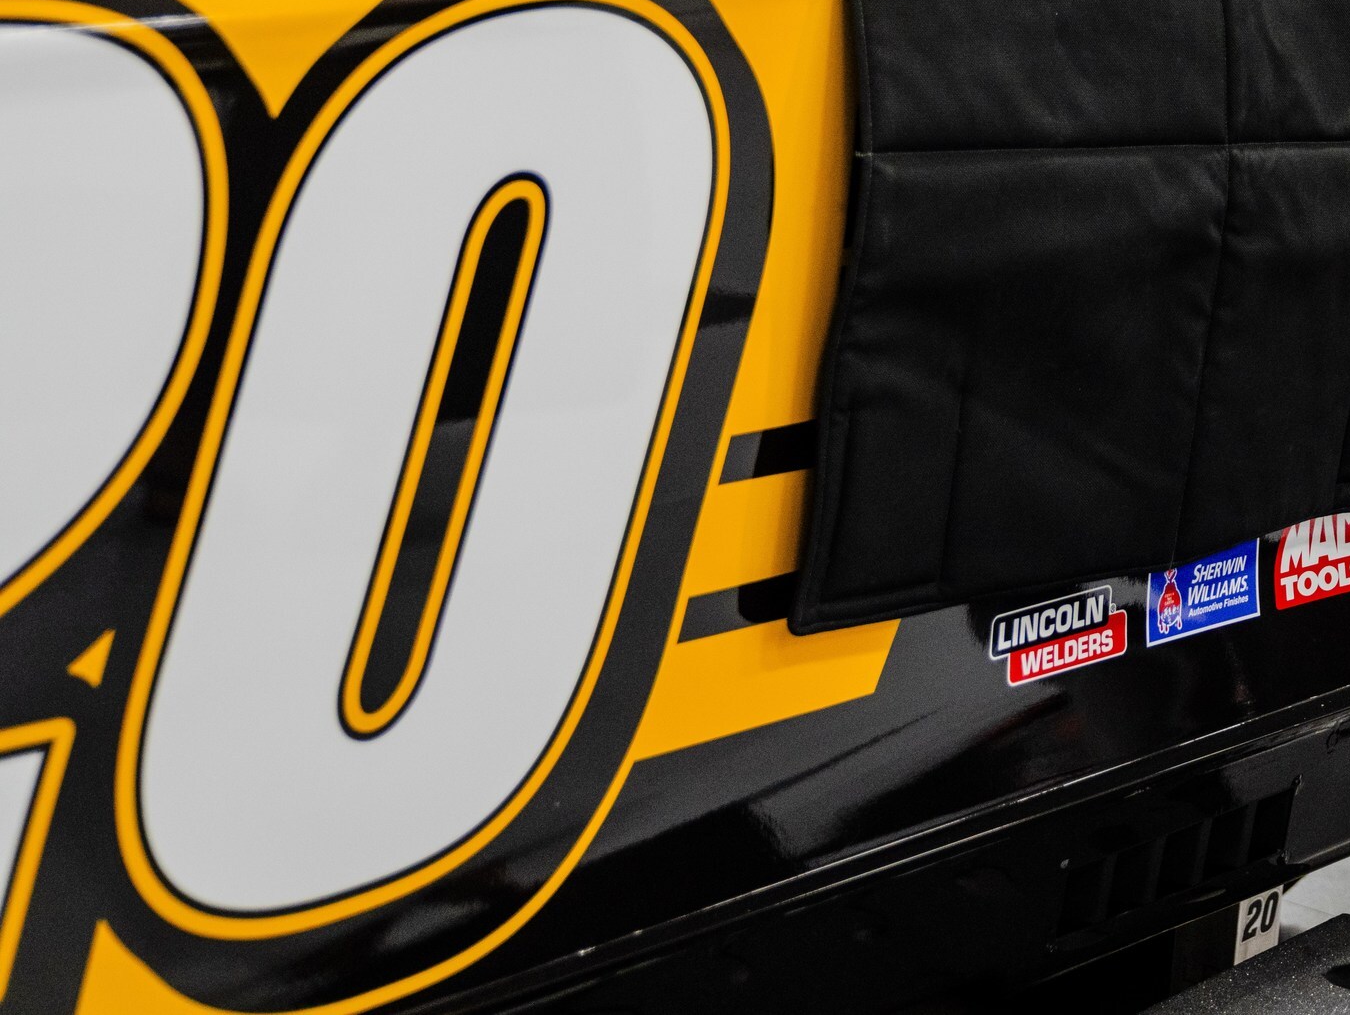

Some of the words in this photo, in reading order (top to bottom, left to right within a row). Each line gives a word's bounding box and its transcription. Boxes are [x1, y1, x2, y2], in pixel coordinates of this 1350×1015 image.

[1191, 555, 1248, 584] SHERWIN
[1187, 575, 1249, 607] WILLIAMS
[1187, 601, 1223, 618] Automotive
[1223, 595, 1249, 608] Finishes
[997, 594, 1105, 652] LINCOLN
[1020, 629, 1114, 677] WELDERS
[1241, 890, 1280, 943] 20
